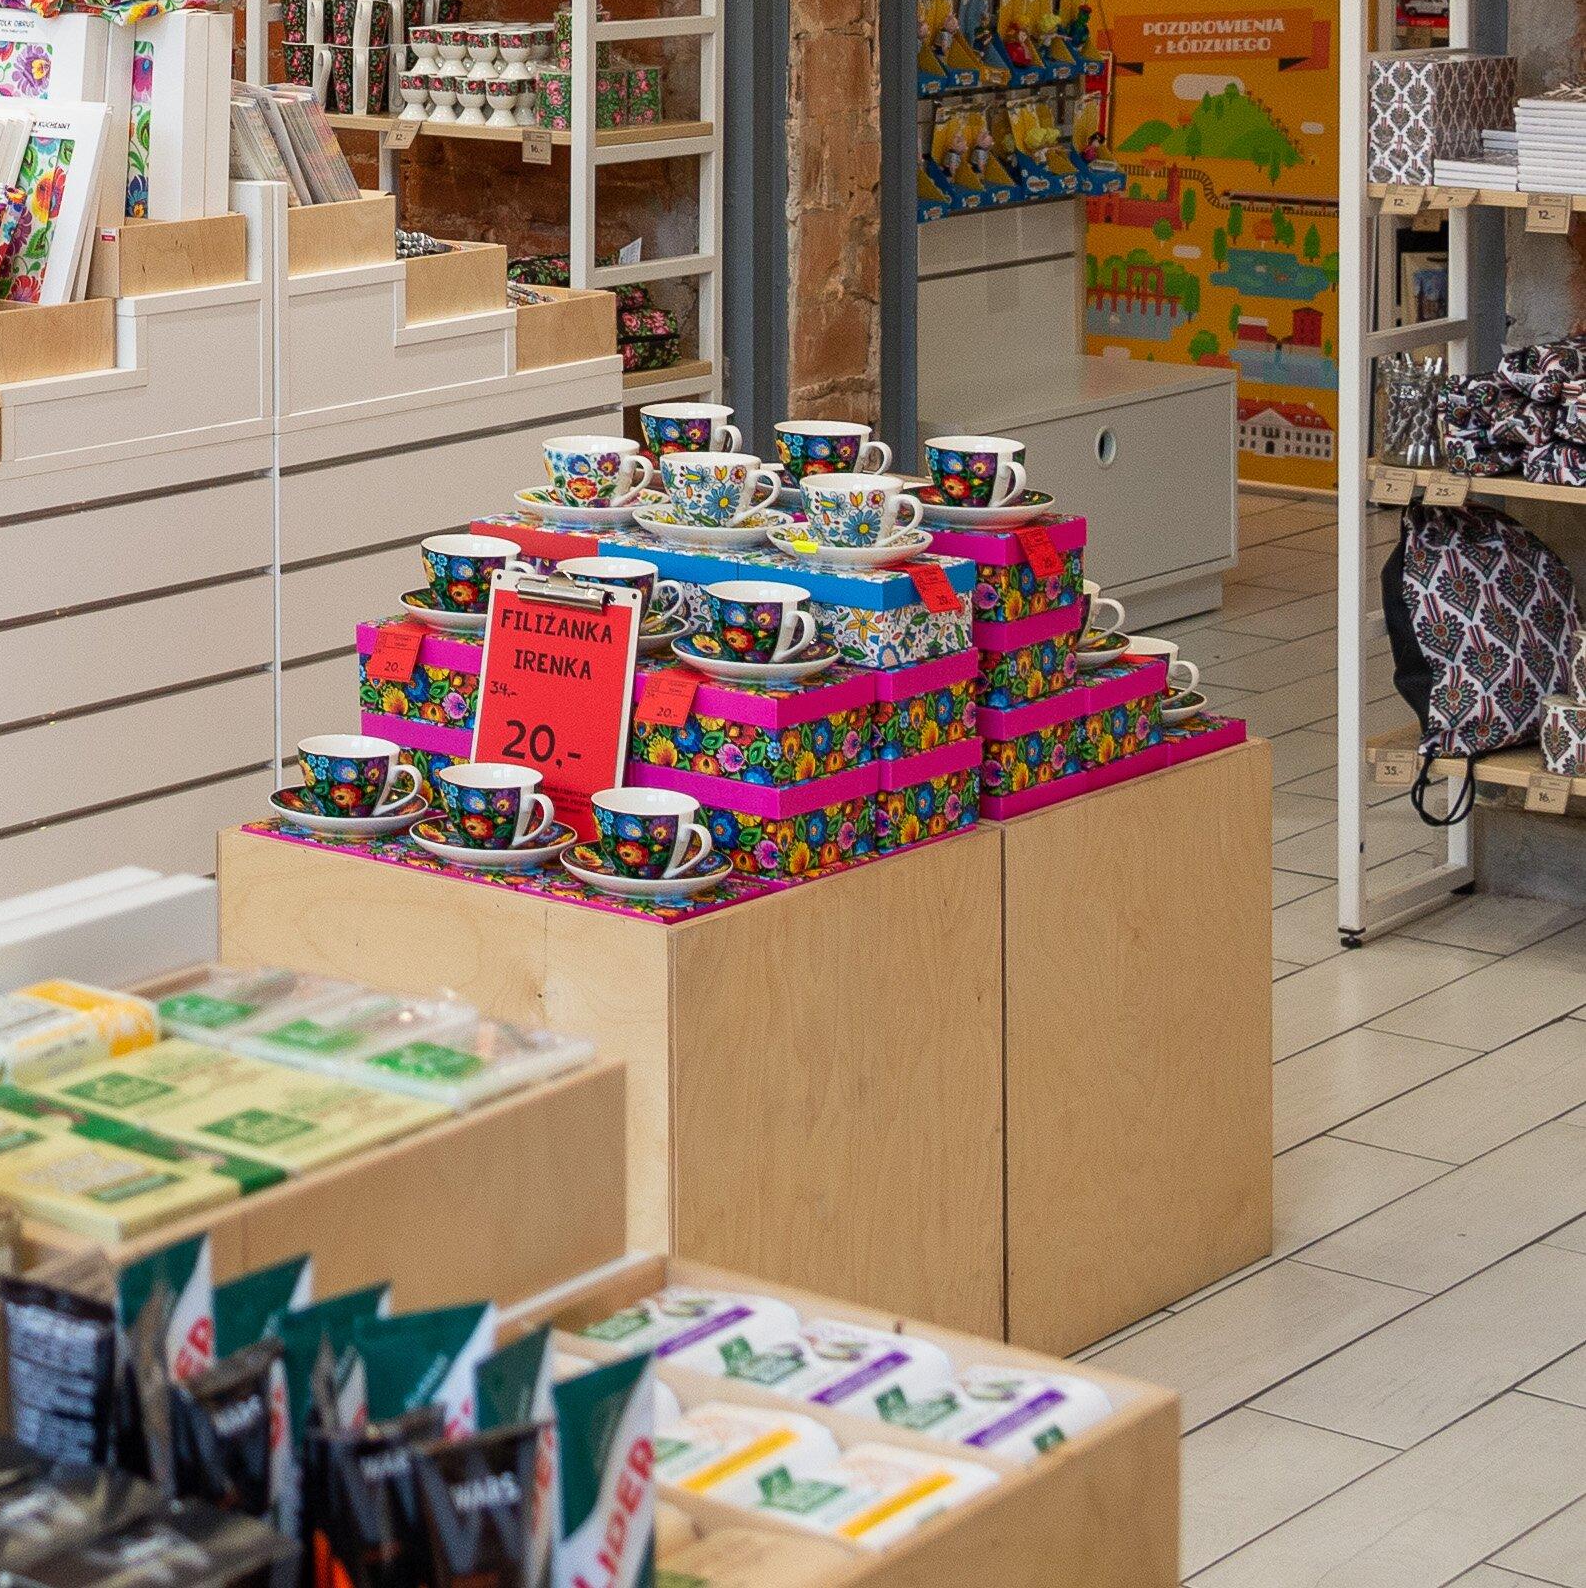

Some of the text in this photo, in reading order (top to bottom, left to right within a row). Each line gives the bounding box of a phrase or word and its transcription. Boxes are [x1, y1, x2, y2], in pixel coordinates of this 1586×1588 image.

[1143, 18, 1285, 36] POZDROWIENIA
[1166, 36, 1271, 54] ŁÓDZKIEGO
[500, 608, 614, 645] FILIŻANKA
[512, 648, 593, 681] IRENKA
